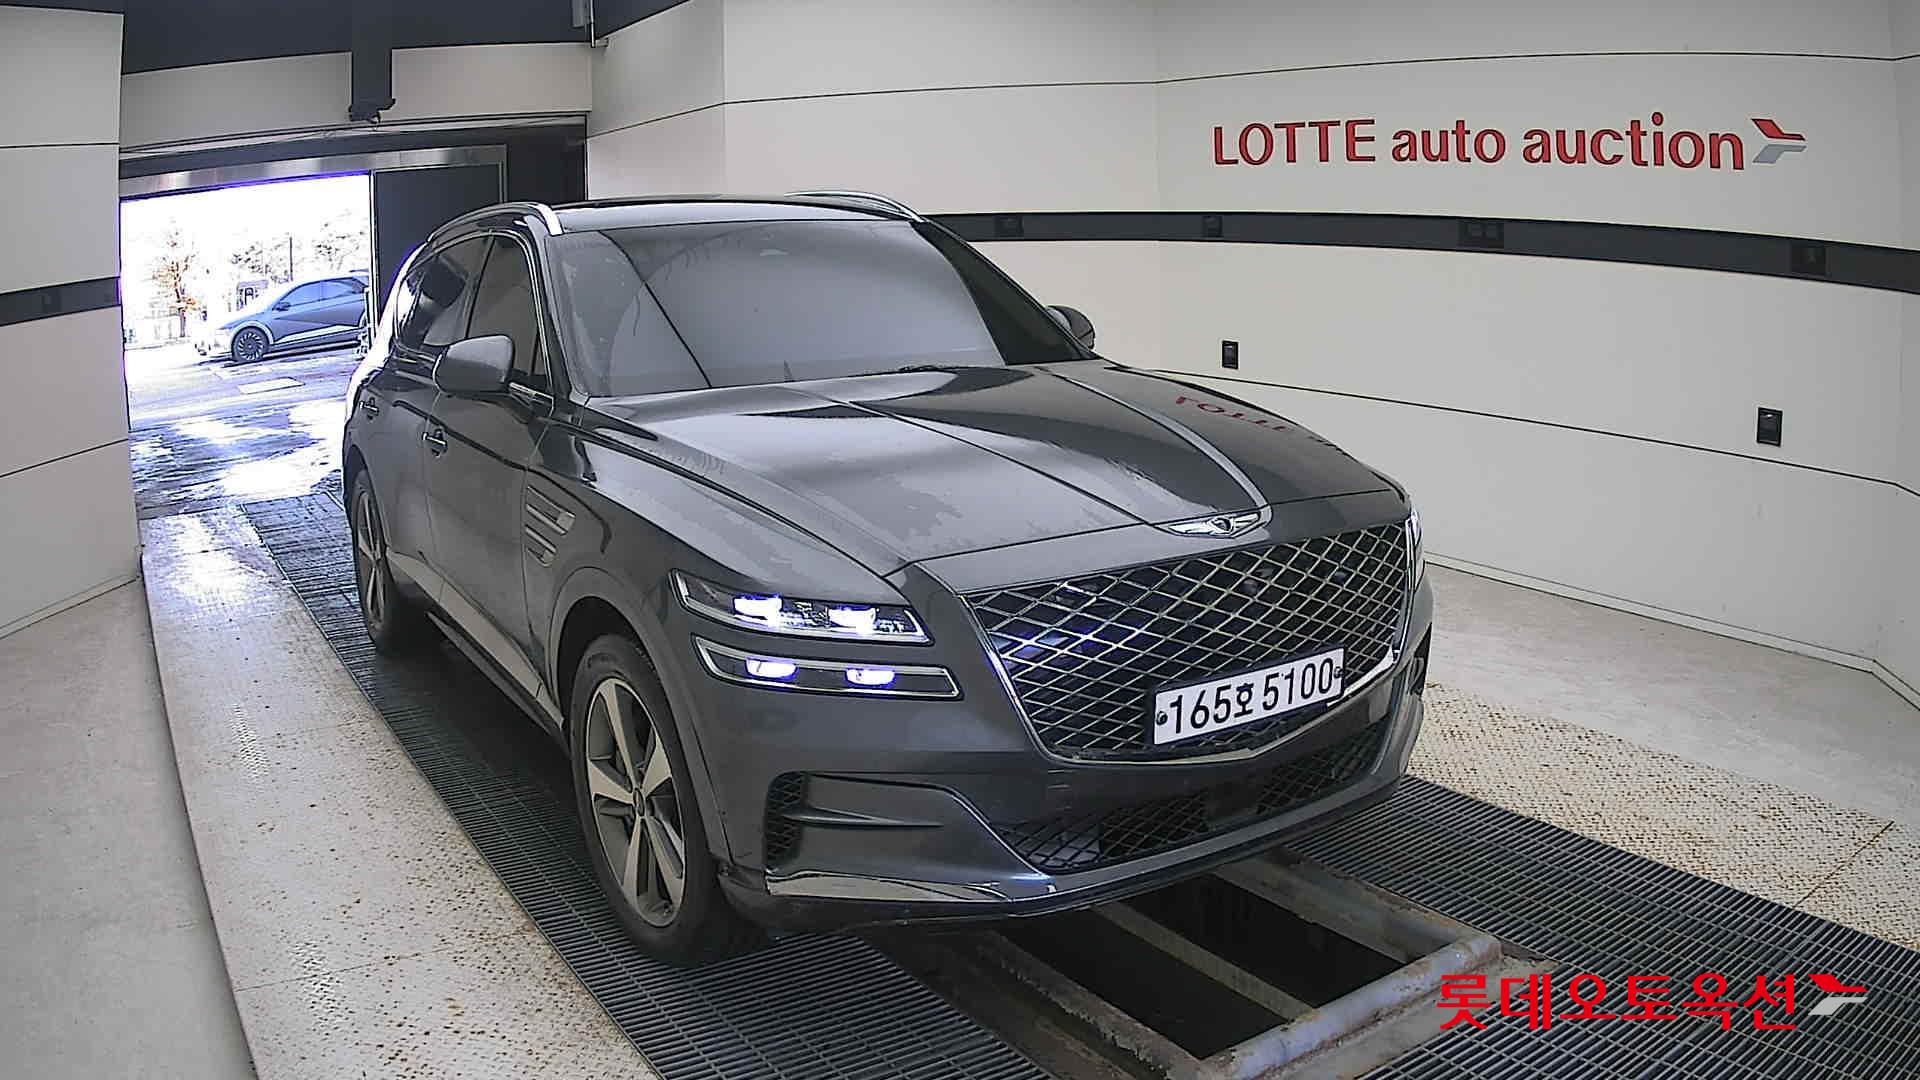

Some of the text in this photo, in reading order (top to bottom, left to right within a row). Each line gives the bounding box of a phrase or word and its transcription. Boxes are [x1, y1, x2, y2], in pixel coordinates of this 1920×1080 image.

[1213, 111, 1745, 170] LOTTE auto auction
[1262, 657, 1334, 711] 5100
